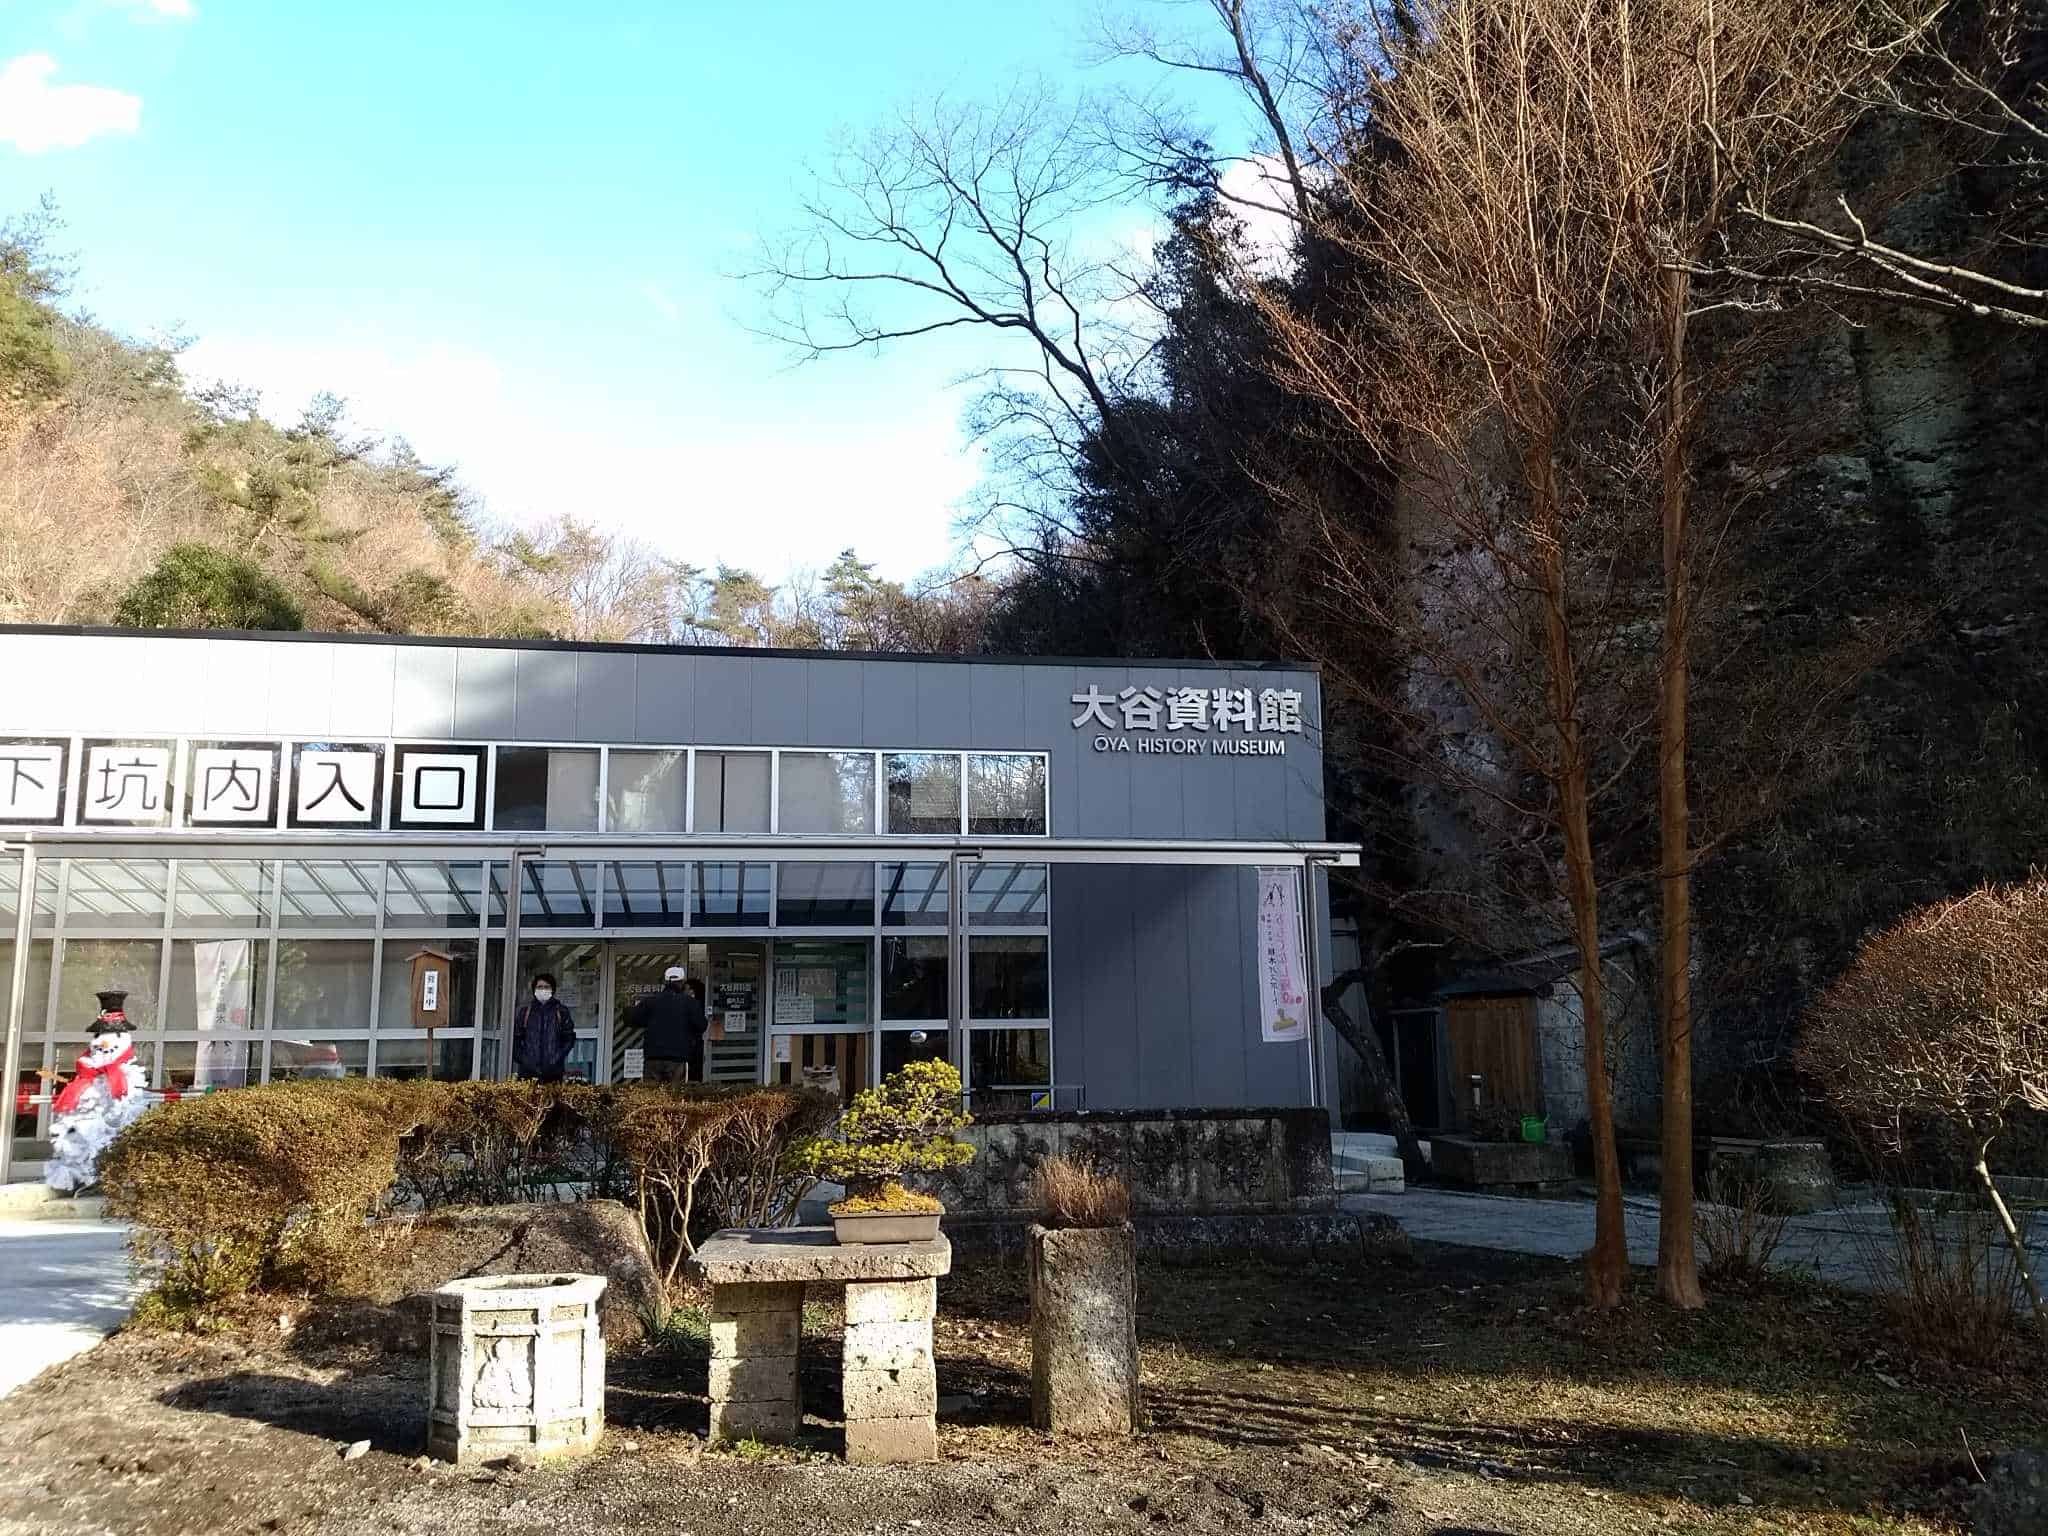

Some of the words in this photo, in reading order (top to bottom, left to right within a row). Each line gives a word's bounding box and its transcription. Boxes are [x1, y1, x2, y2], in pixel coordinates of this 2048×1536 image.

[1071, 684, 1302, 733] 大谷資料館
[1137, 738, 1207, 754] HISTORY
[1212, 739, 1286, 756] MUSEUM
